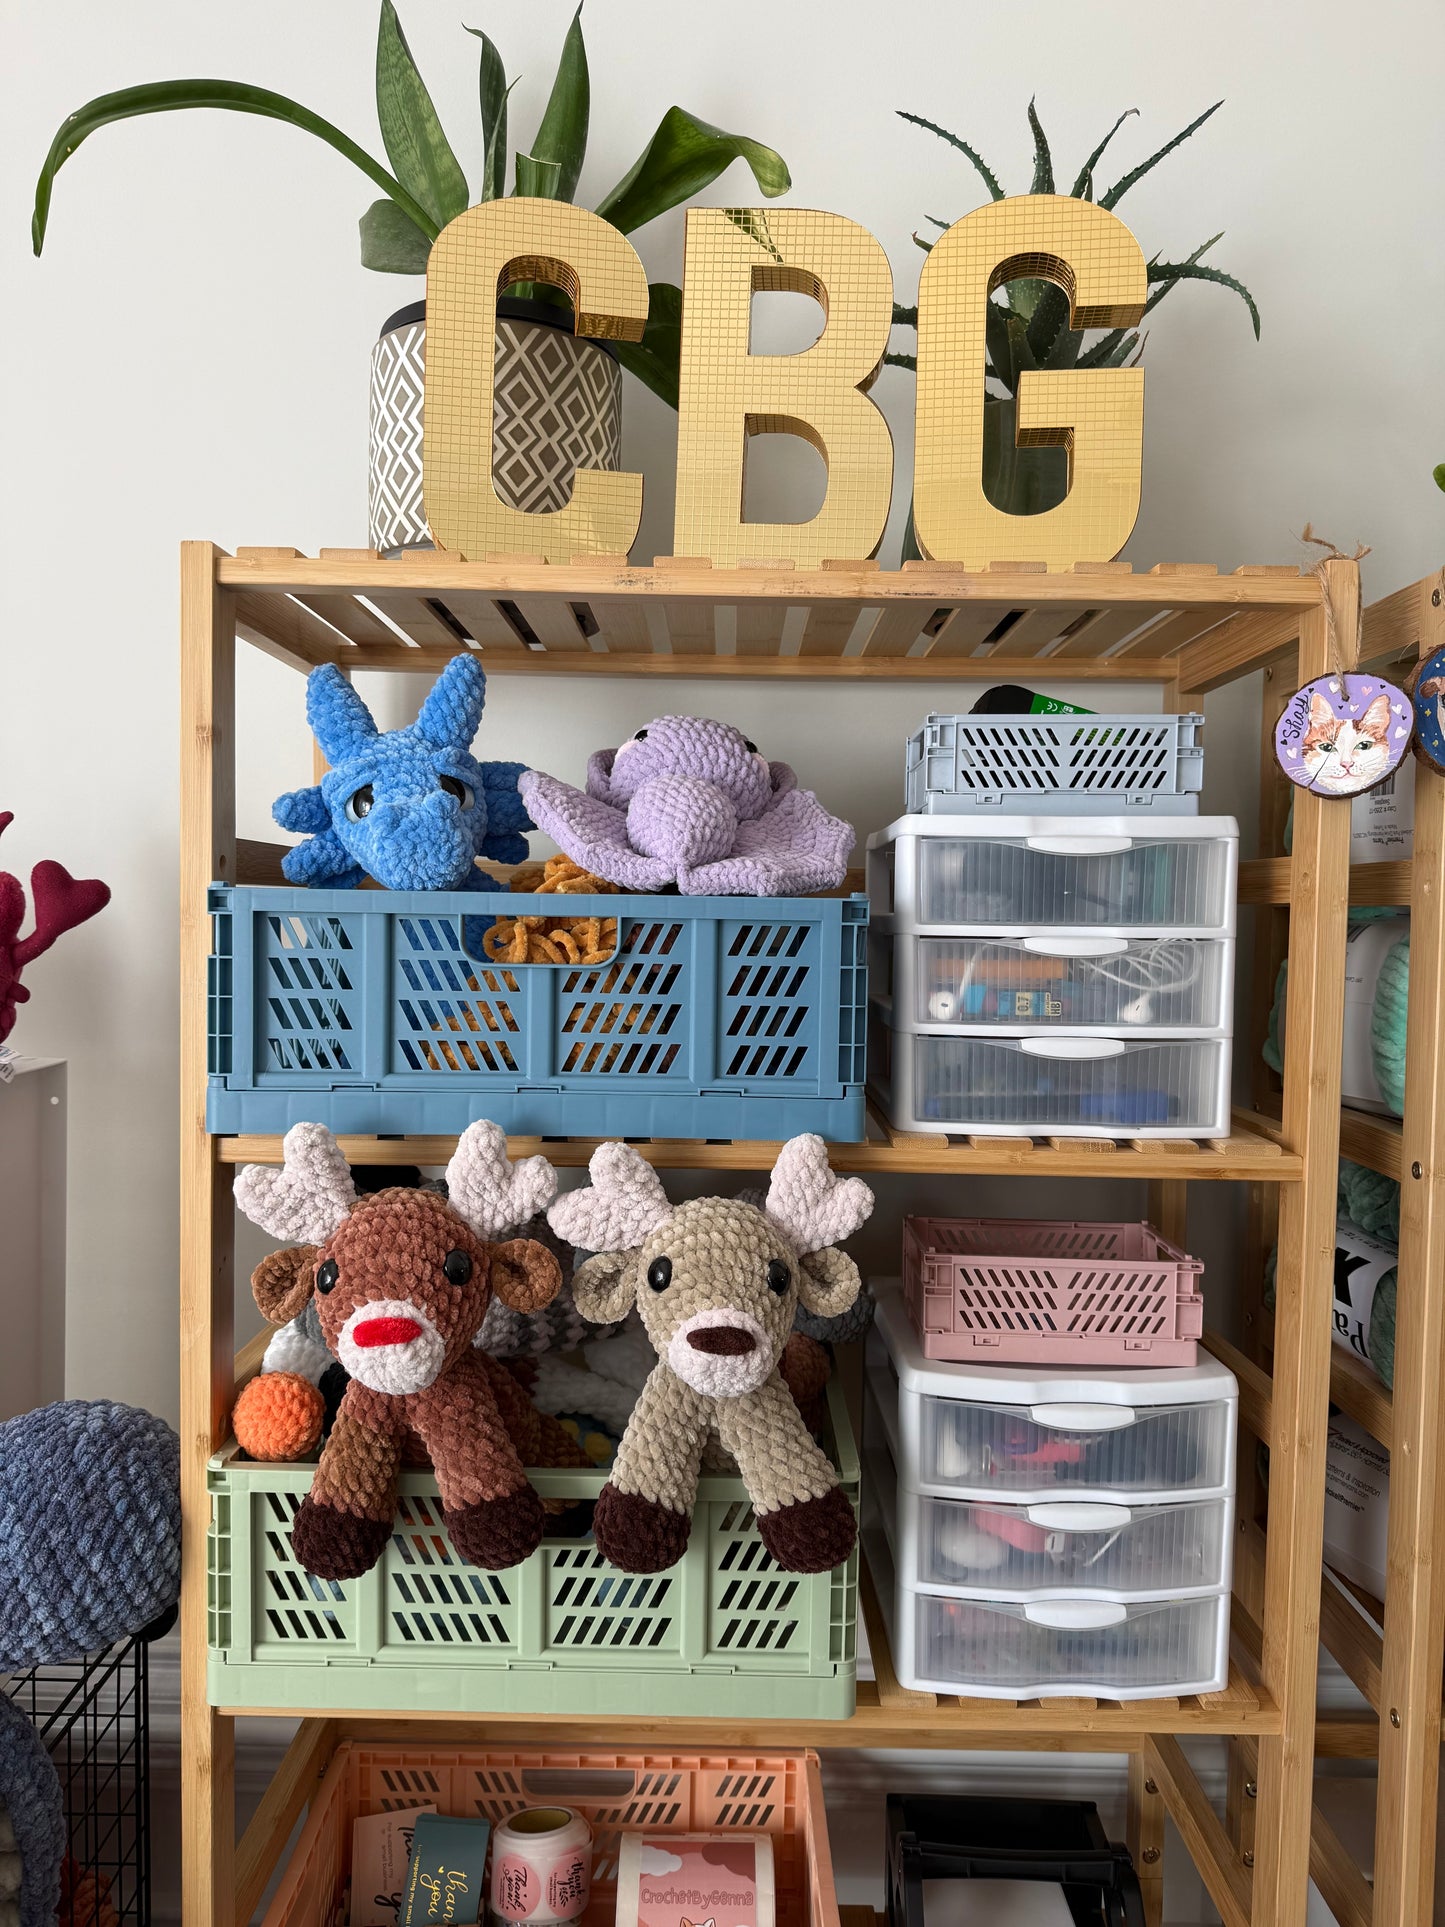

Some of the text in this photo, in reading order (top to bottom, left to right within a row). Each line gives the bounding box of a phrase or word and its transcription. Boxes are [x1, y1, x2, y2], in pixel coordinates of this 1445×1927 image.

[1282, 694, 1309, 739] Shay
[1017, 995, 1029, 1012] 0.7
[409, 1855, 420, 1891] supporting
[513, 1866, 528, 1912] Thank
[556, 1869, 576, 1898] you
[571, 1857, 586, 1904] thank
[405, 1905, 413, 1924] small
[407, 1892, 415, 1904] my
[419, 1873, 442, 1919] you
[442, 1871, 469, 1923] than
